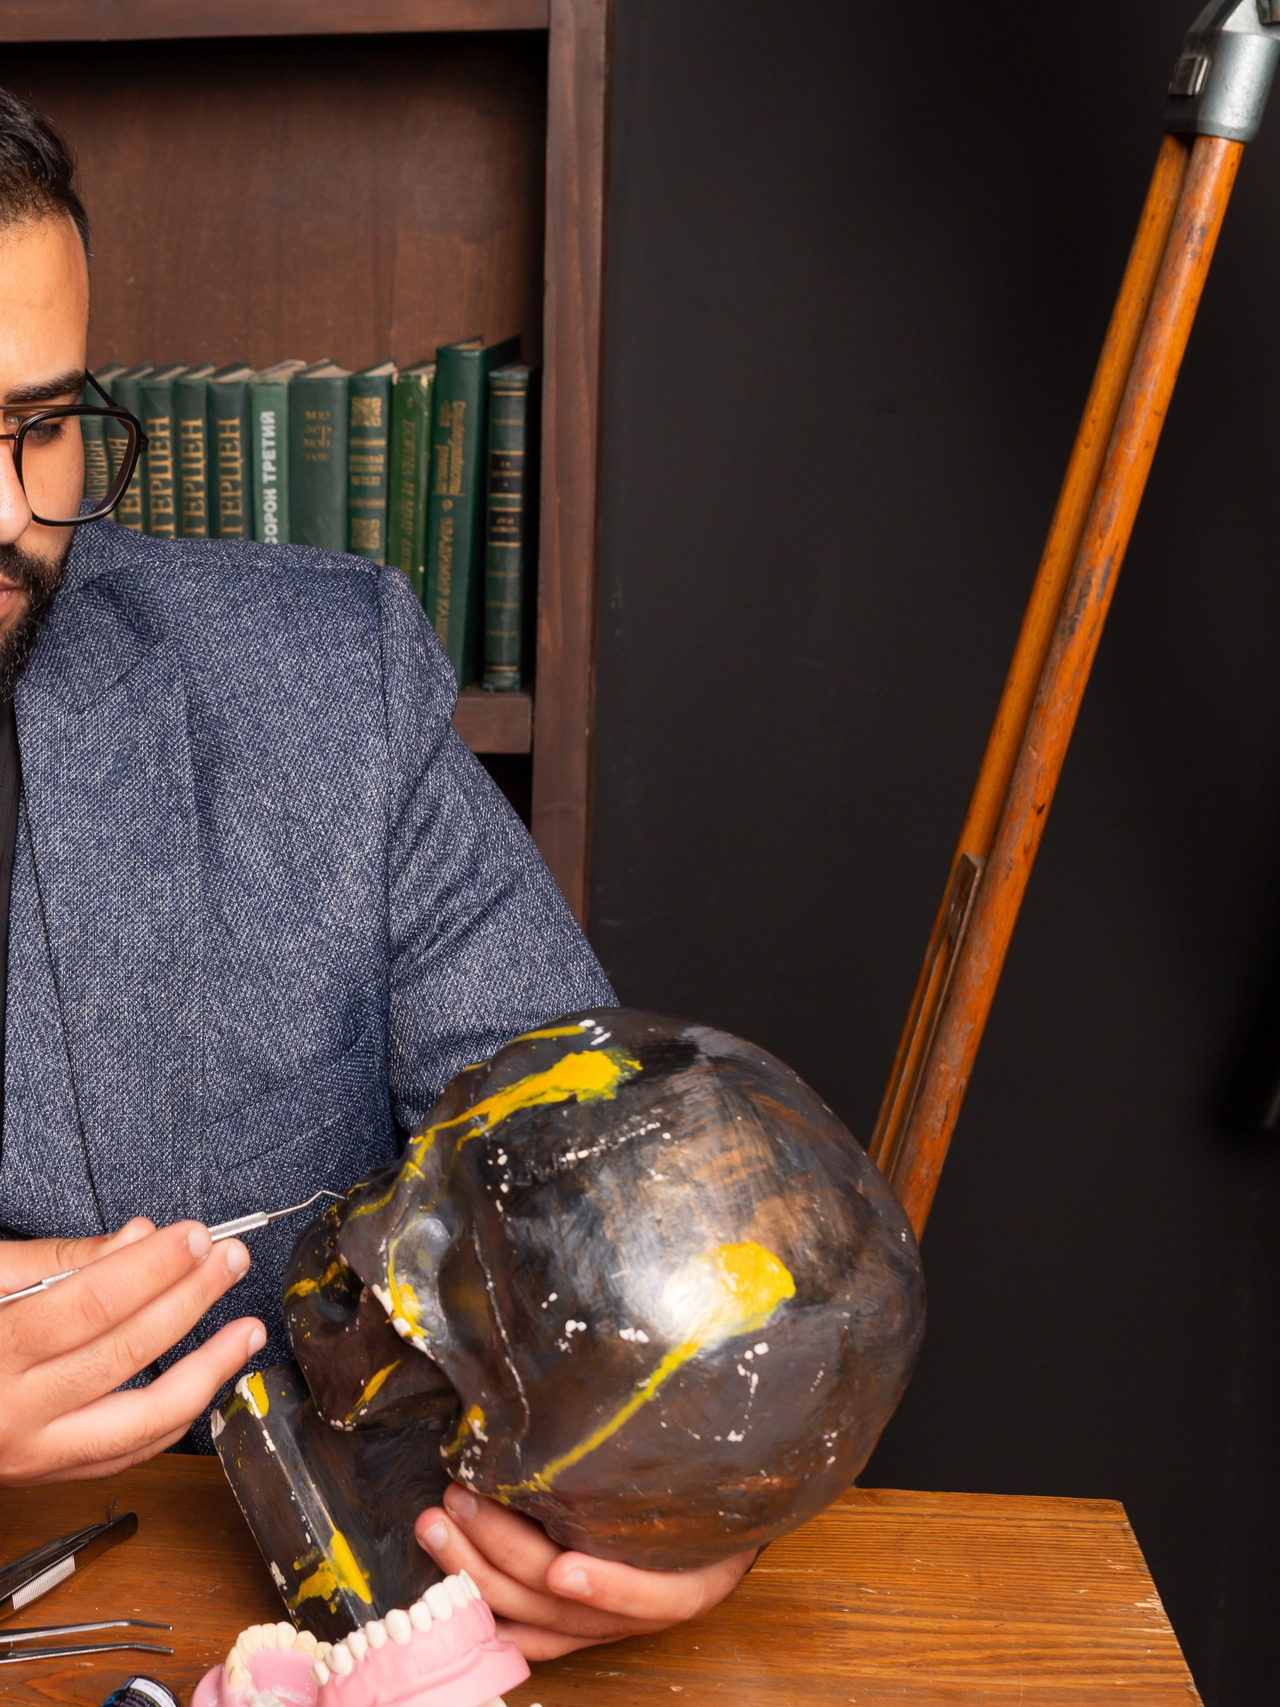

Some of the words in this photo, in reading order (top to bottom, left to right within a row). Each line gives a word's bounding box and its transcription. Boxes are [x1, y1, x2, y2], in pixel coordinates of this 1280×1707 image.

[180, 418, 205, 535] ГЕРЦЕН
[260, 411, 276, 483] ТРЕТИЙ
[263, 488, 278, 543] СОРОК
[438, 517, 454, 596] ВЛАДИМИР
